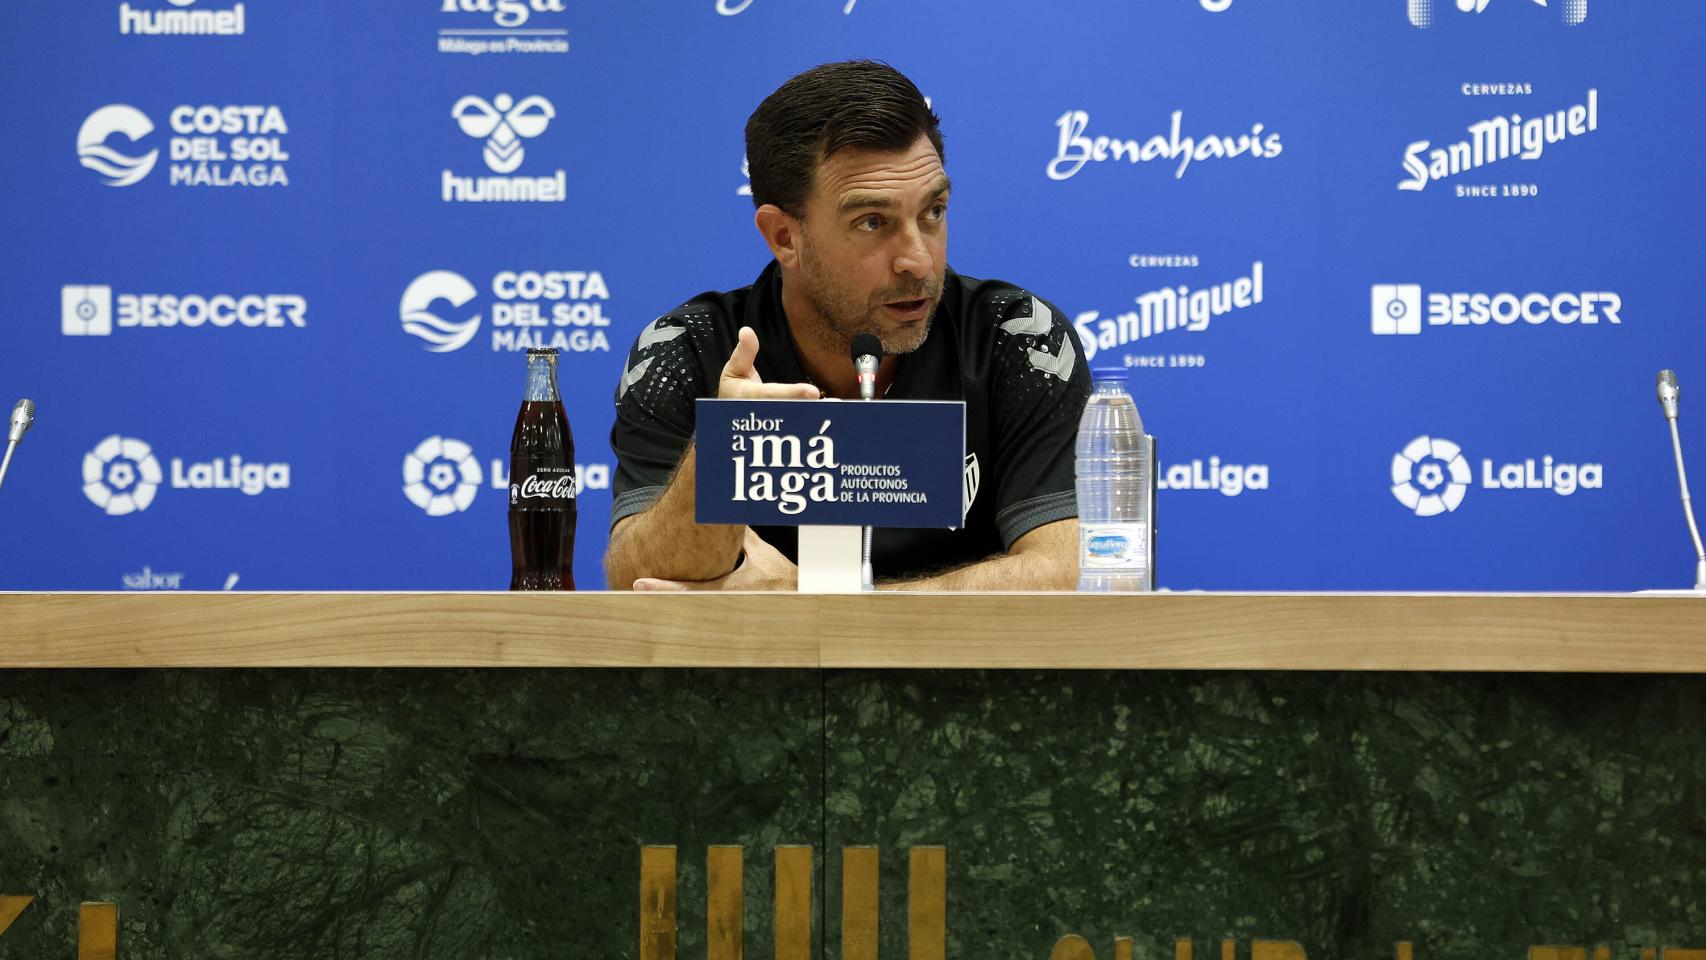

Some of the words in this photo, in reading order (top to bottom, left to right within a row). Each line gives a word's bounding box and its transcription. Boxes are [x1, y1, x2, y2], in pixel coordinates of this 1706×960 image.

[119, 3, 245, 35] hummel
[1461, 83, 1533, 96] CERVEZAS
[170, 105, 288, 134] COSTA
[170, 138, 226, 161] DEL
[230, 138, 289, 161] SOL
[170, 161, 289, 187] MÁLAGA
[441, 170, 566, 202] hummel
[1456, 184, 1497, 197] SINCE
[1502, 184, 1538, 197] 1890
[1129, 255, 1199, 268] CERVEZAS
[492, 271, 610, 300] COSTA
[117, 294, 307, 328] BESOCCER
[492, 302, 549, 327] DEL
[552, 302, 611, 327] SOL
[1428, 292, 1622, 326] BESOCCER
[492, 326, 610, 352] MÁLAGA
[1123, 354, 1165, 368] SINCE
[1169, 354, 1205, 368] 1890
[731, 412, 784, 432] sabor
[731, 434, 747, 452] a
[171, 455, 290, 496] LaLiga
[840, 464, 901, 477] PRODUCTOS
[840, 475, 908, 490] AUTÓCTONOS
[1482, 455, 1603, 496] LaLiga
[731, 456, 840, 515] laga
[840, 491, 854, 503] DE
[858, 492, 870, 503] LA
[872, 492, 928, 504] PROVINCIA
